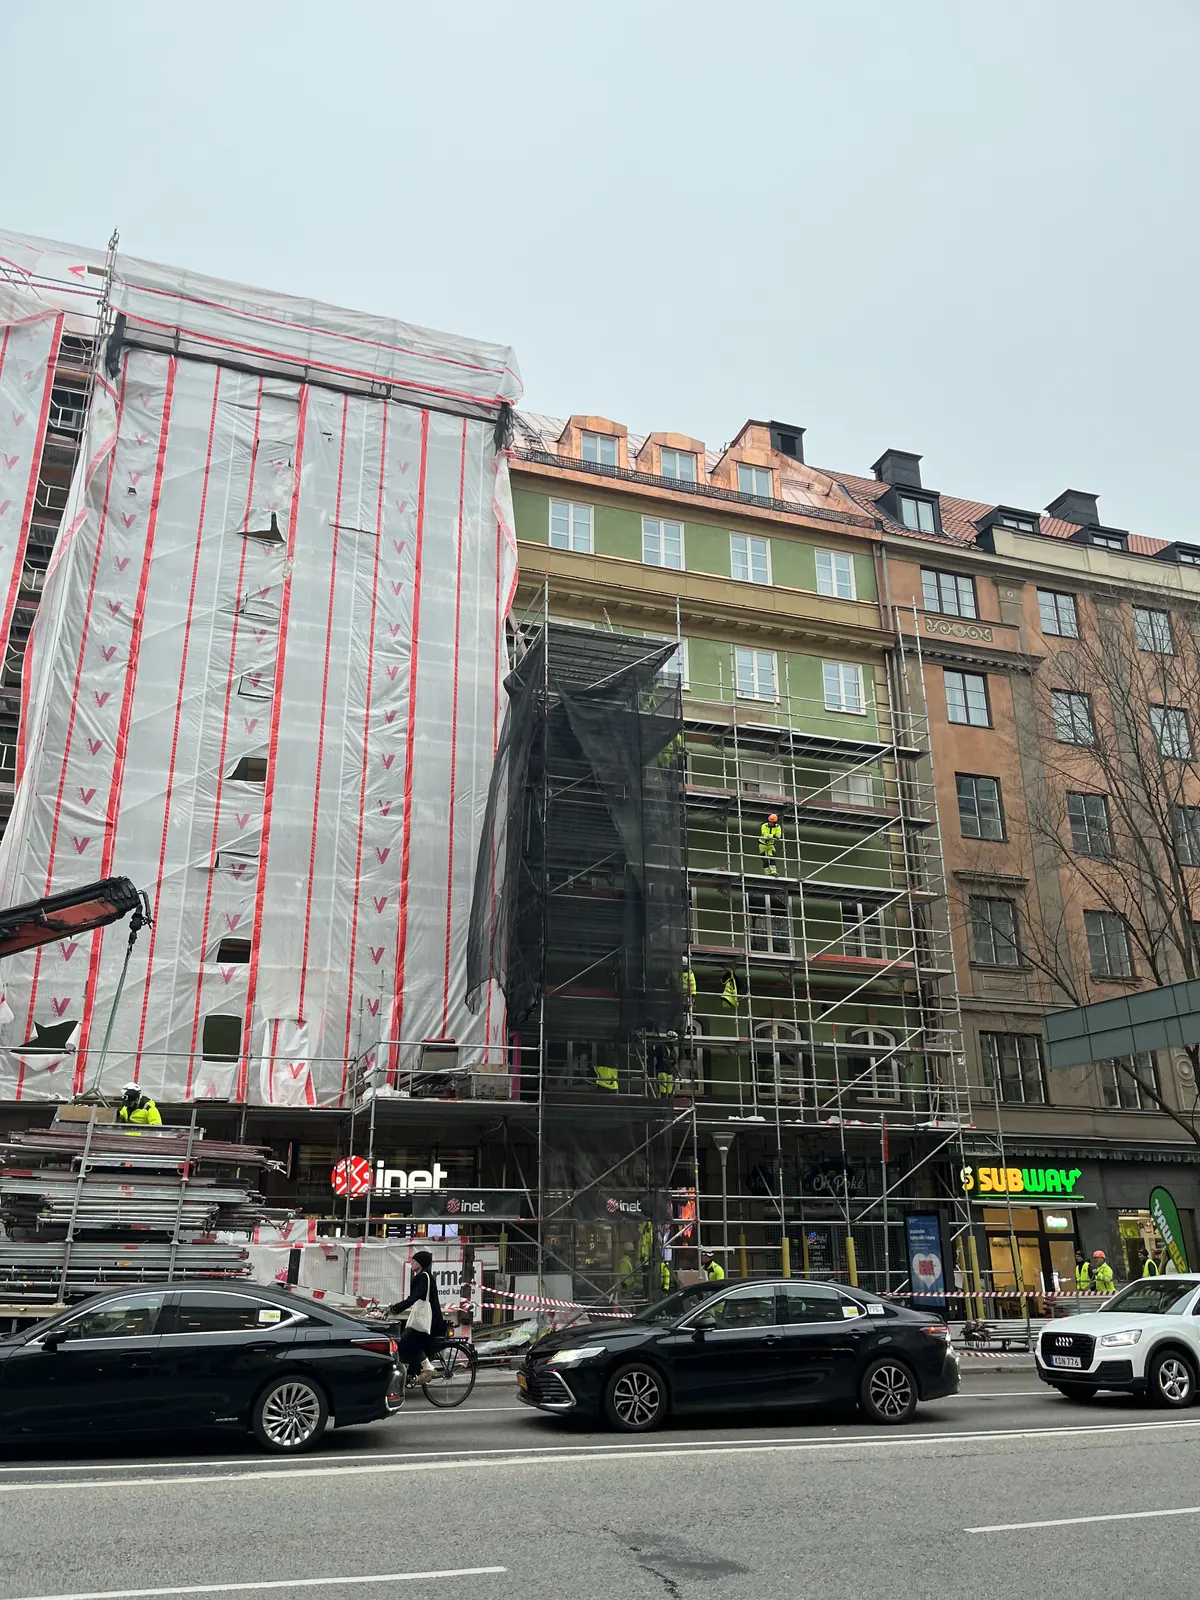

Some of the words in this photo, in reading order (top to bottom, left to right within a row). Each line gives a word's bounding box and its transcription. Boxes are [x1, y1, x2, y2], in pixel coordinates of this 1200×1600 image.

[374, 1160, 447, 1196] inet
[978, 1167, 1082, 1192] SUBWAY
[460, 1200, 485, 1213] inet
[619, 1200, 642, 1213] inet
